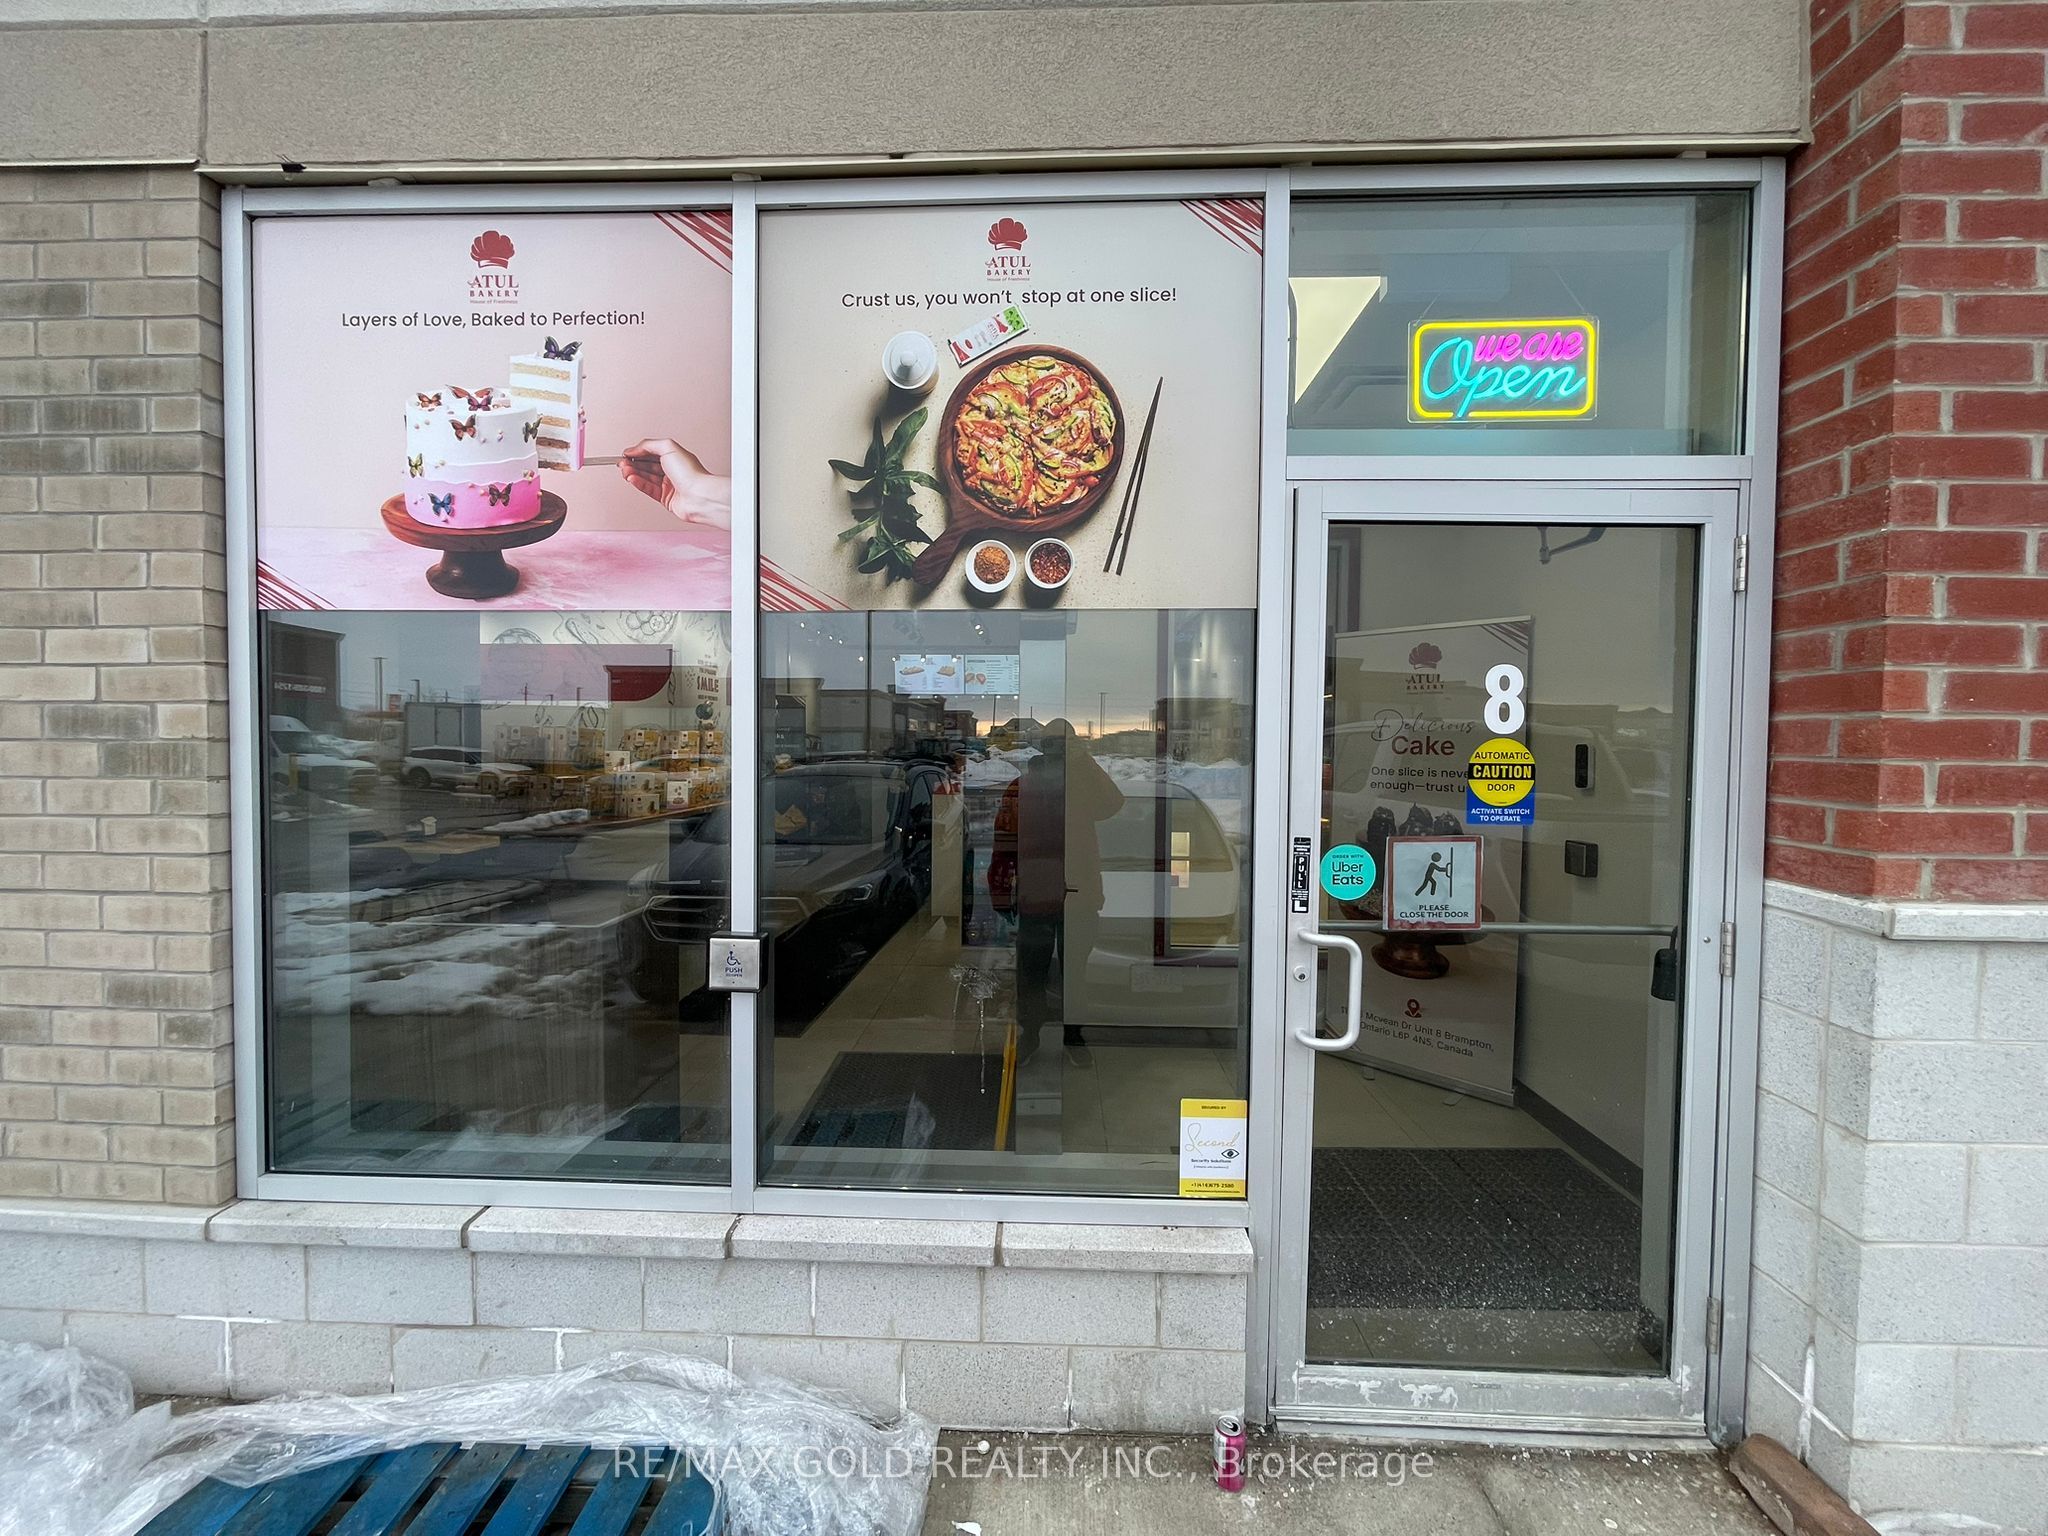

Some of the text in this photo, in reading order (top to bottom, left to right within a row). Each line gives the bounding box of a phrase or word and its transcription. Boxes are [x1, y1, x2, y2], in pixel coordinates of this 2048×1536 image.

[985, 256, 1031, 268] ATUL
[467, 274, 519, 288] ATUL
[842, 293, 890, 307] Crust
[895, 294, 920, 308] us,
[925, 294, 957, 310] you
[1022, 290, 1061, 307] stop
[1067, 289, 1086, 302] at
[1090, 290, 1124, 302] one
[1130, 287, 1176, 302] slice!
[342, 311, 644, 331] Layers of Love, Baked to Perfection!
[1474, 331, 1584, 362] we are
[1422, 337, 1586, 418] Open
[1484, 664, 1525, 735] 8
[1371, 708, 1476, 741] Delicious
[1392, 736, 1455, 755] Cake
[1371, 766, 1395, 776] One
[1398, 767, 1424, 777] slice
[1428, 768, 1438, 777] is
[1473, 765, 1532, 778] CAUTION
[1332, 862, 1363, 872] Uber
[1332, 874, 1364, 885] Eats
[1360, 1021, 1390, 1036] Ontario
[1393, 1030, 1410, 1040] L6P
[1437, 1040, 1473, 1057] Canada
[1366, 1012, 1399, 1027] Mcvean
[1402, 1021, 1411, 1030] Dr
[1414, 1024, 1433, 1035] Unit
[1445, 1032, 1494, 1052] Brampton,
[1185, 1122, 1240, 1156] Second
